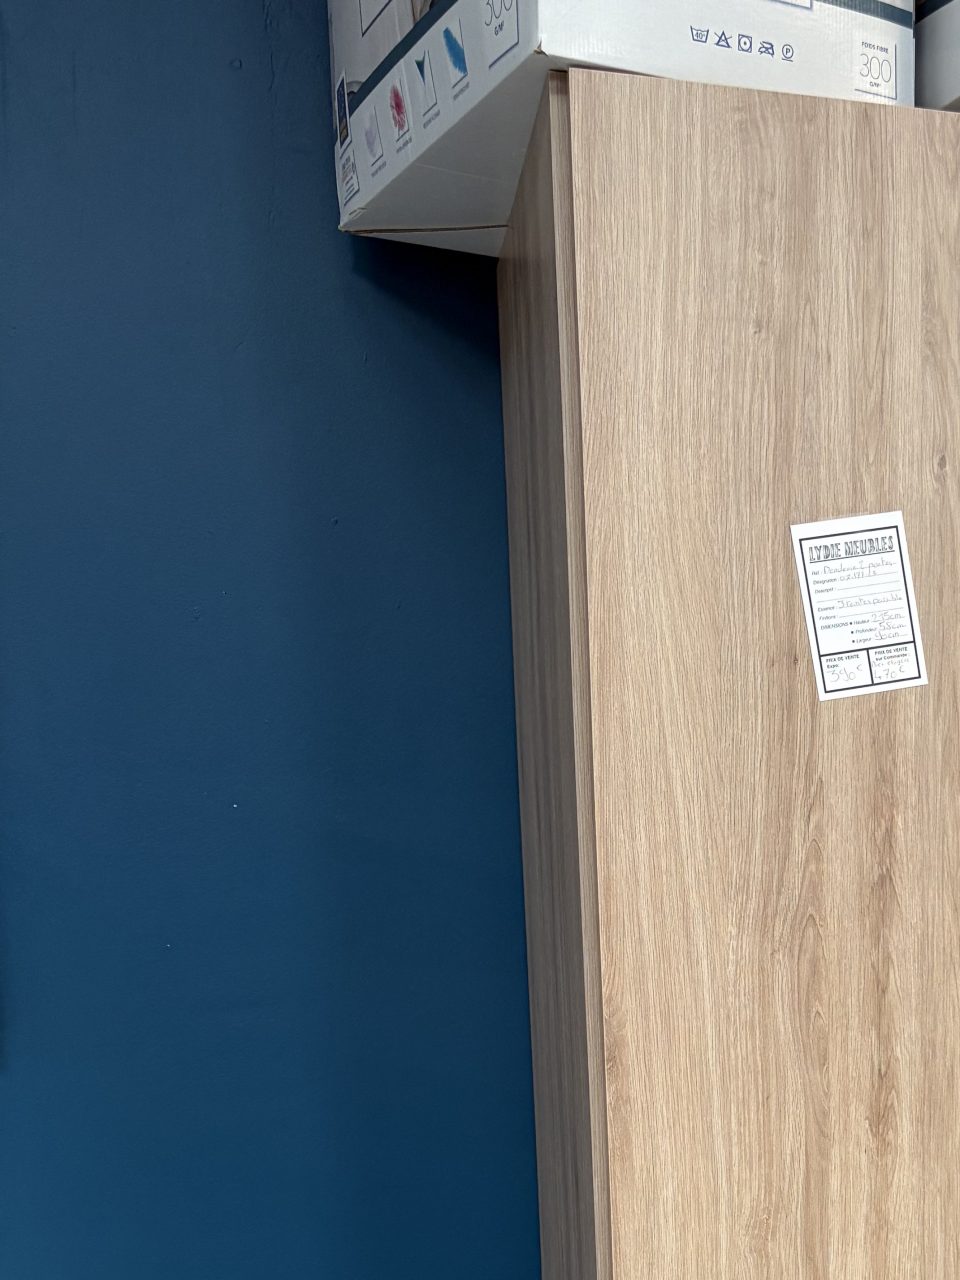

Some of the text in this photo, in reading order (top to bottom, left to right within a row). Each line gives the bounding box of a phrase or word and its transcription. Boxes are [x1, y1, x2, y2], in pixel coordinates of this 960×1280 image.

[859, 53, 892, 83] 300
[809, 536, 894, 562] LYDIE MEUBLES
[820, 622, 849, 631] DIMENSIONS
